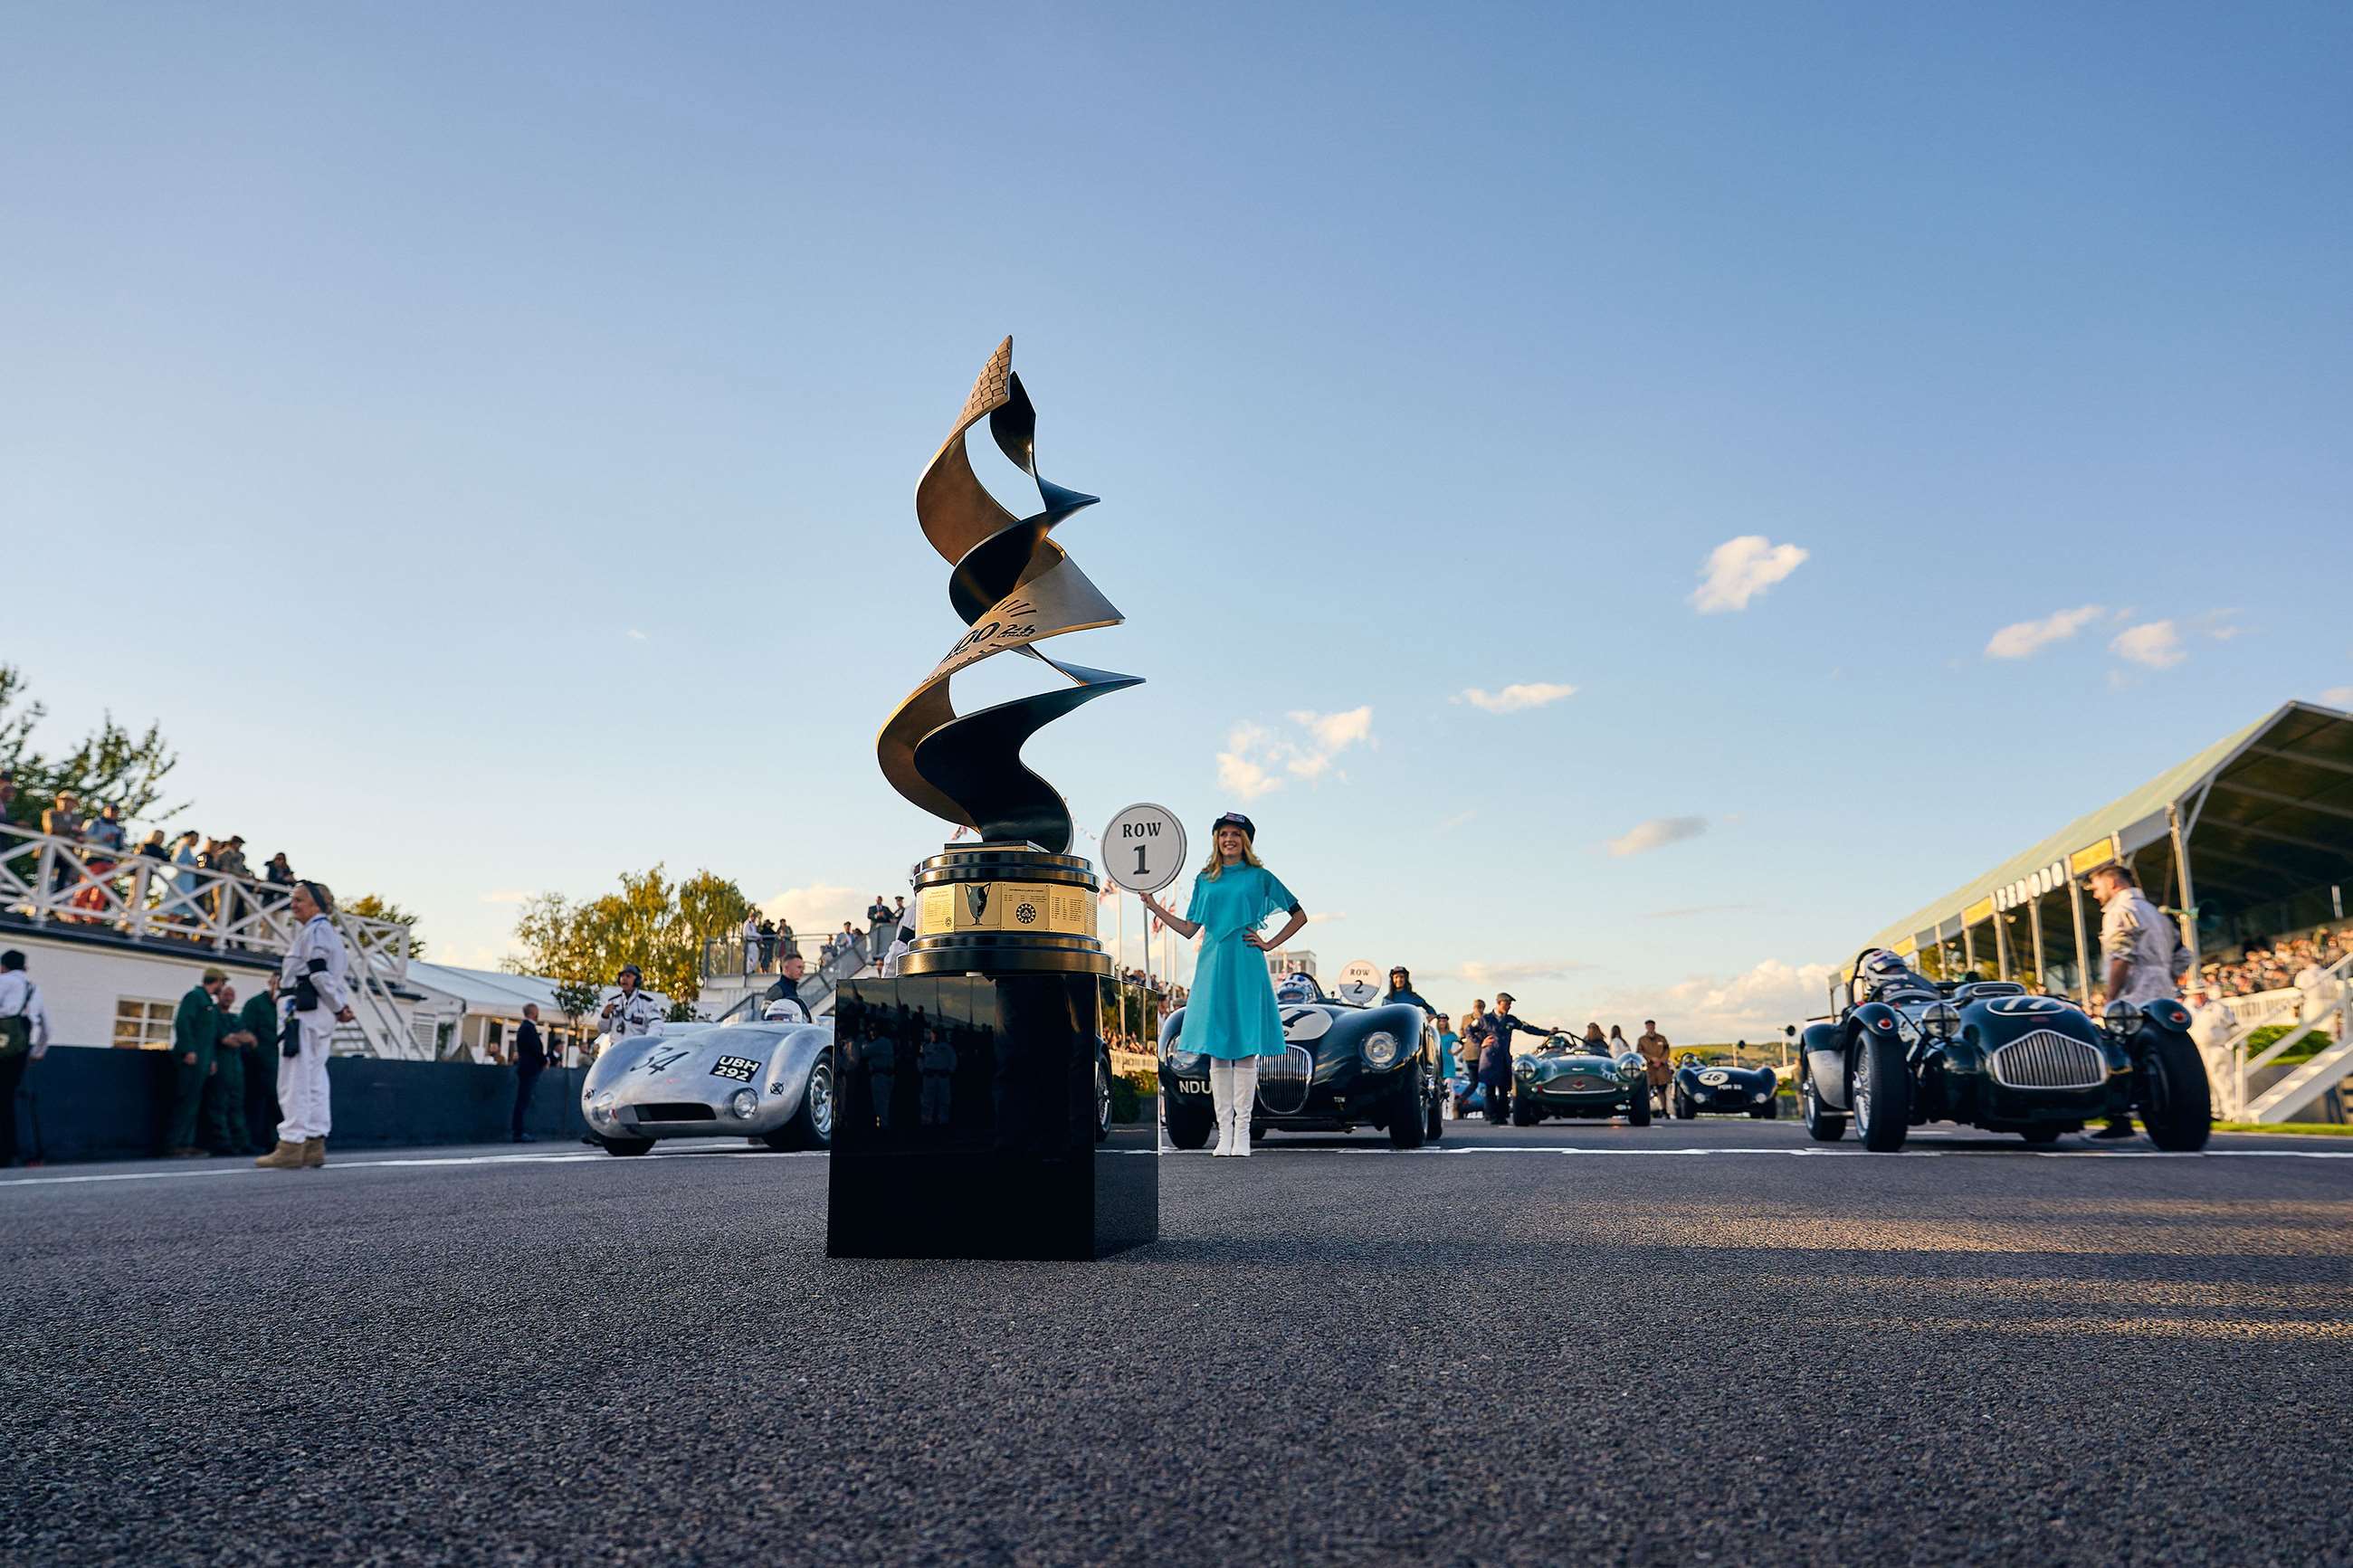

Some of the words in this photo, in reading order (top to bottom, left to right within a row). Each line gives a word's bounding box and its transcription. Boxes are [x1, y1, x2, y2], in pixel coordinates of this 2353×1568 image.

[1122, 822, 1161, 838] ROW
[1133, 844, 1150, 875] 1
[1349, 968, 1370, 976] ROW
[1353, 979, 1364, 994] 2
[629, 1046, 691, 1076] 34
[719, 1056, 759, 1072] UBH
[714, 1066, 750, 1081] 292
[1704, 1073, 1723, 1082] 16
[1178, 1080, 1213, 1095] NDU
